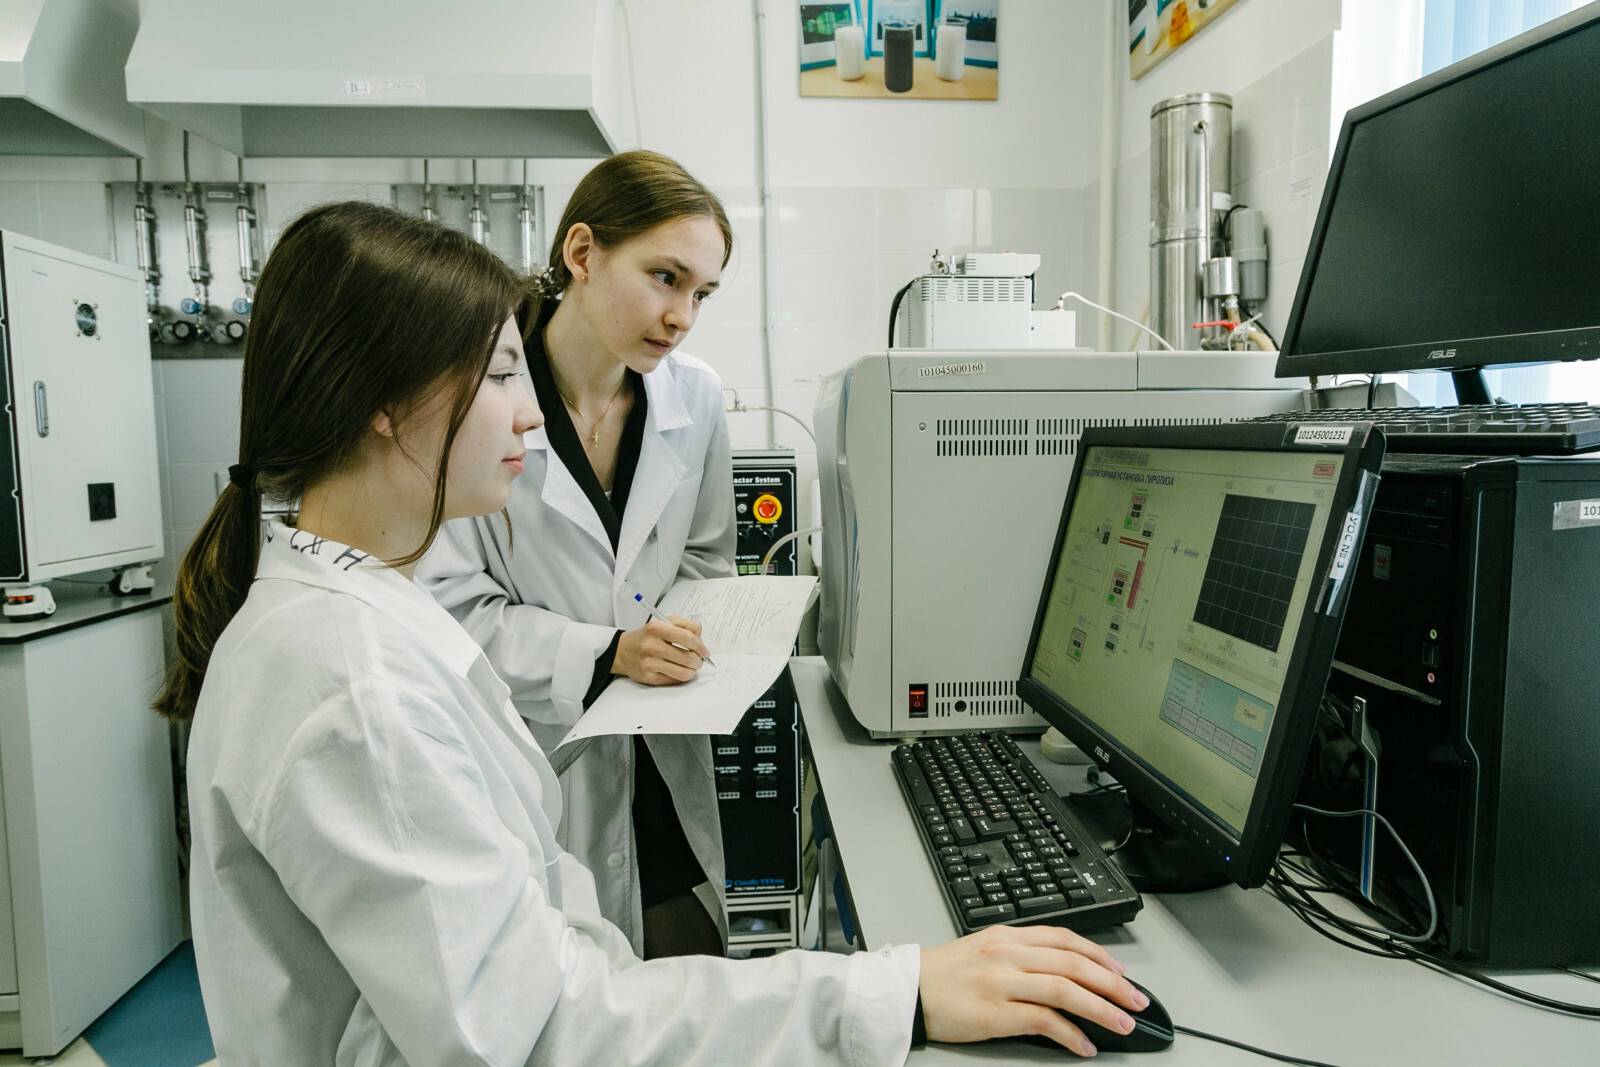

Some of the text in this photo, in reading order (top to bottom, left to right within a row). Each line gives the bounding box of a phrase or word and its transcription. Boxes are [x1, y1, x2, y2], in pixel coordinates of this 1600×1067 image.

[1427, 349, 1457, 360] ASUS
[920, 362, 983, 377] 101045000160
[1297, 430, 1347, 440] 101245001231
[755, 476, 781, 484] System
[1336, 561, 1345, 569] 3
[1094, 746, 1110, 763] ASUS
[1083, 872, 1096, 886] SVEN
